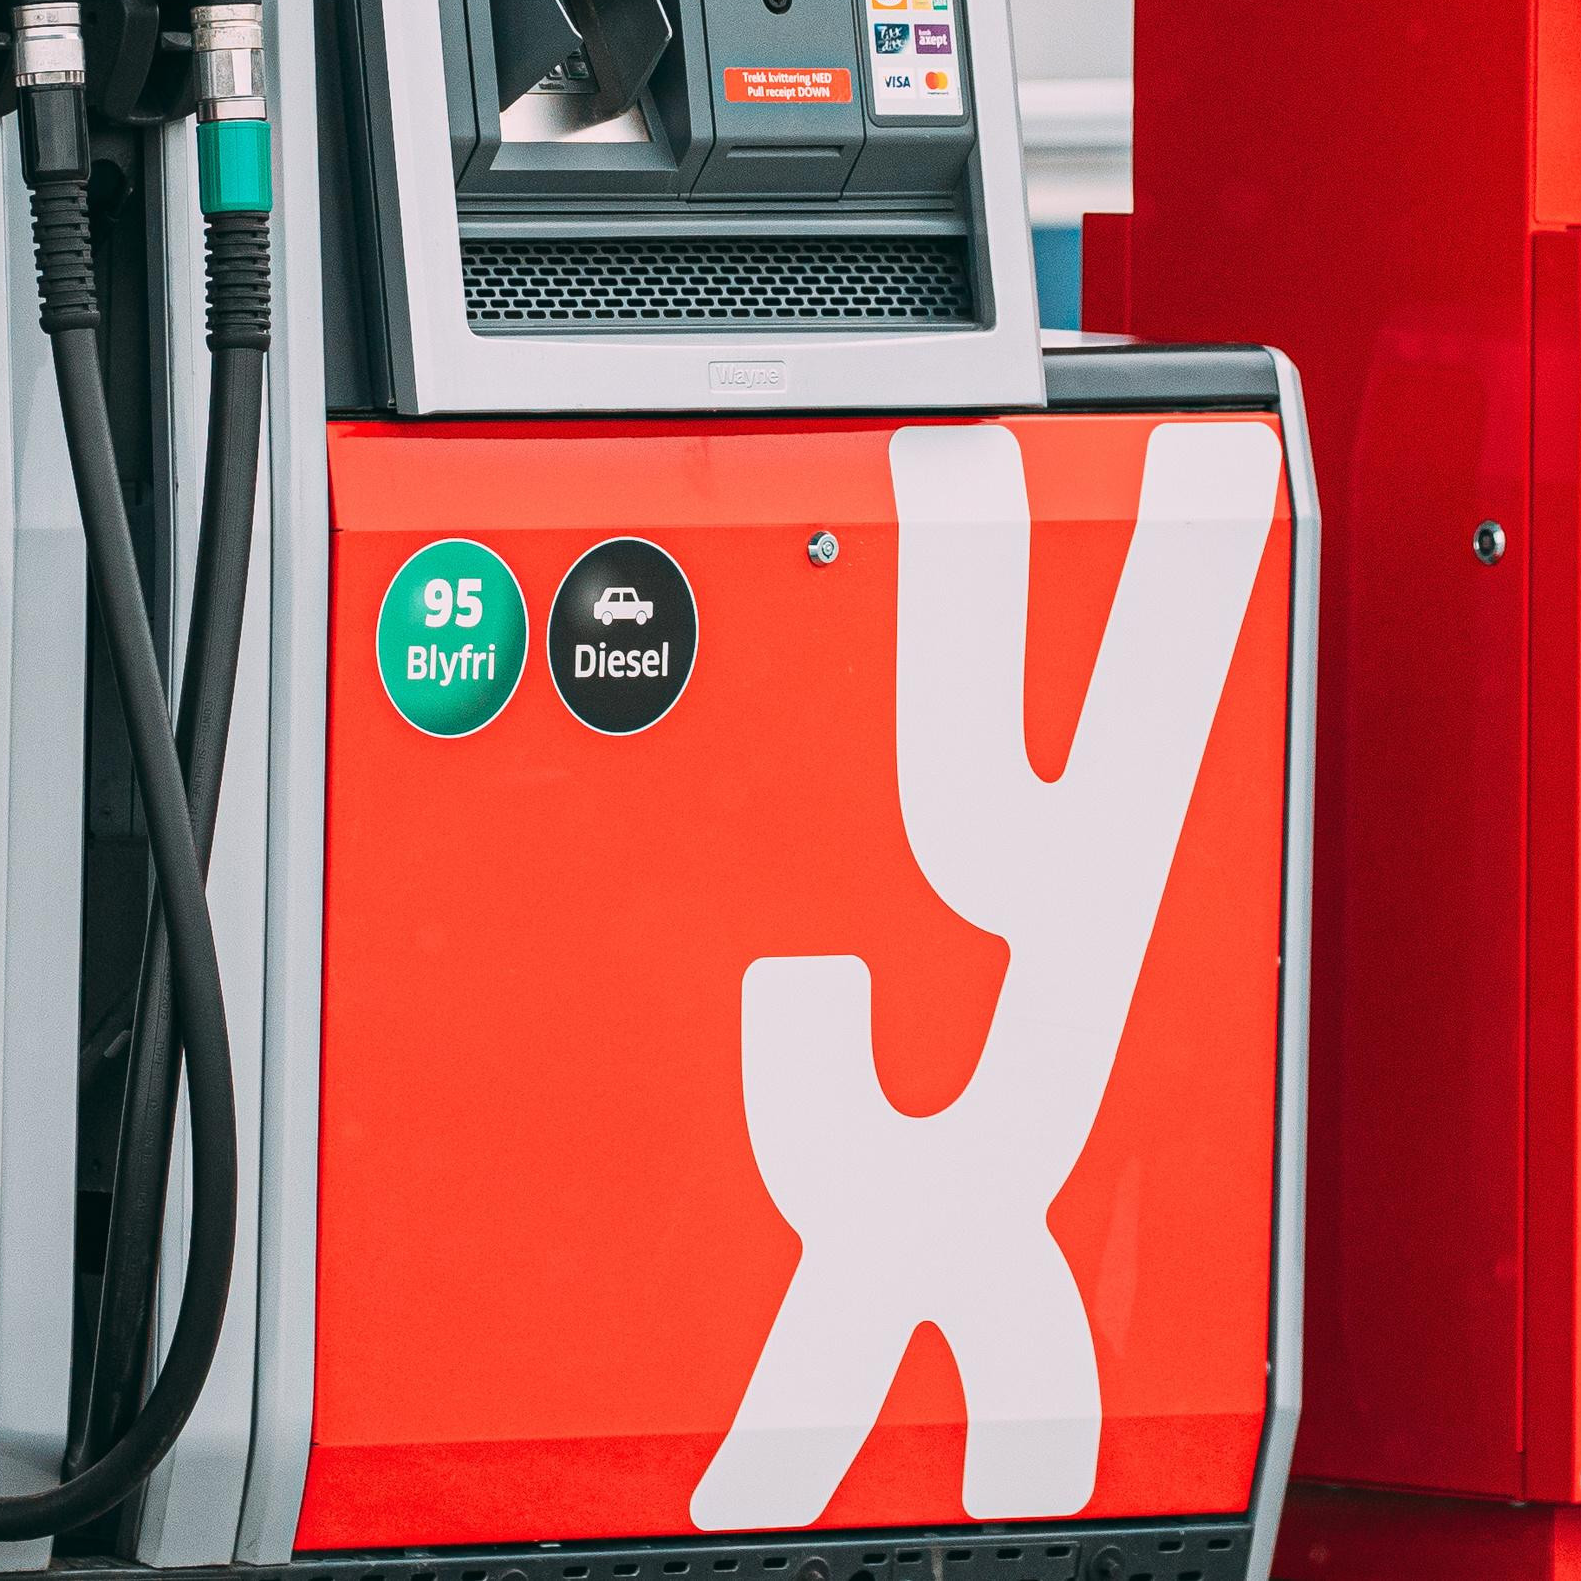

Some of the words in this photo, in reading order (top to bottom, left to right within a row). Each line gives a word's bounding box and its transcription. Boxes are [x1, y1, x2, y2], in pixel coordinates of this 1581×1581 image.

[919, 34, 948, 48] axept
[742, 72, 767, 83] Trekk
[768, 72, 811, 86] kvittering
[812, 72, 832, 83] NED
[884, 76, 911, 88] VISA
[747, 86, 764, 97] Pull
[766, 86, 796, 99] receipt
[798, 86, 830, 97] DOWN
[715, 366, 779, 388] Wayne
[424, 578, 483, 629] 95
[406, 644, 496, 687] Blyfri
[574, 641, 669, 679] Diesel
